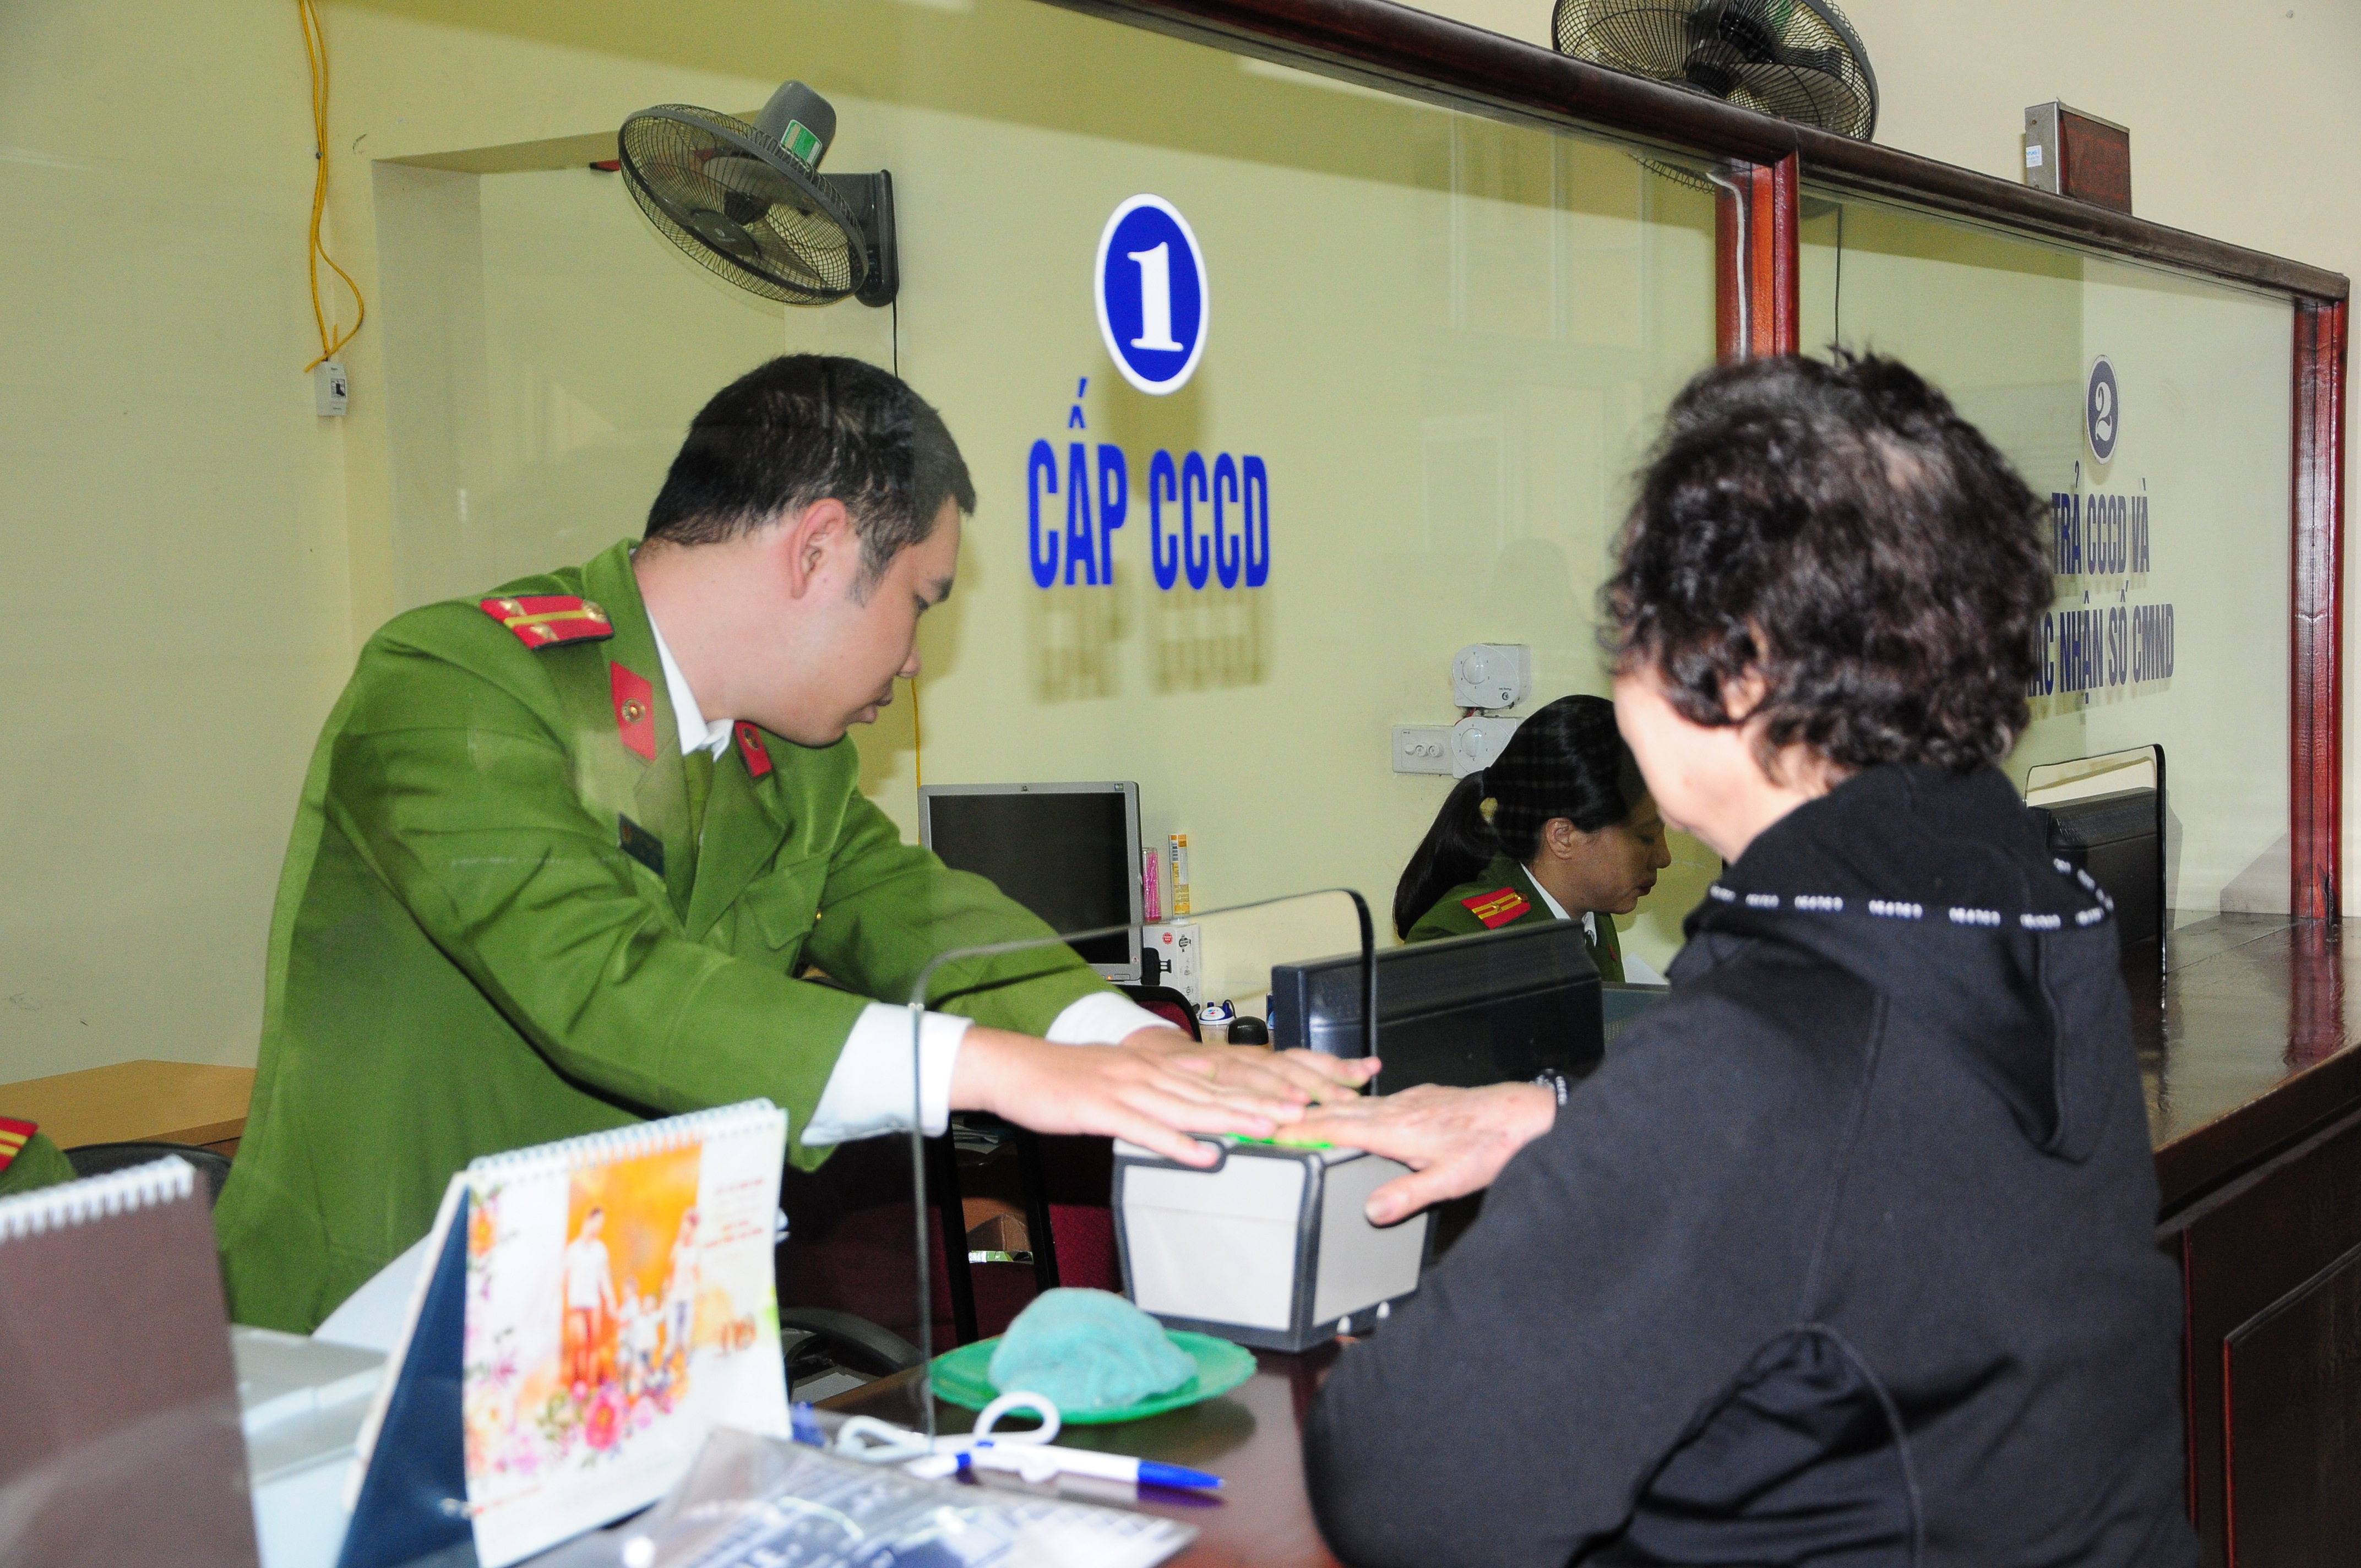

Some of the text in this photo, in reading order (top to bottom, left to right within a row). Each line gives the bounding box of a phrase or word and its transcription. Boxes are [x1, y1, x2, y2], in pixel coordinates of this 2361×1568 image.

[1127, 241, 1183, 352] 1
[2095, 381, 2113, 442] 2
[1027, 377, 1271, 591] CẤP CCCD
[2052, 460, 2150, 575] TRẢ CCCD VÀ
[2059, 590, 2103, 704] NHẬN
[2108, 580, 2129, 688] SỐ
[2132, 603, 2174, 683] CMND
